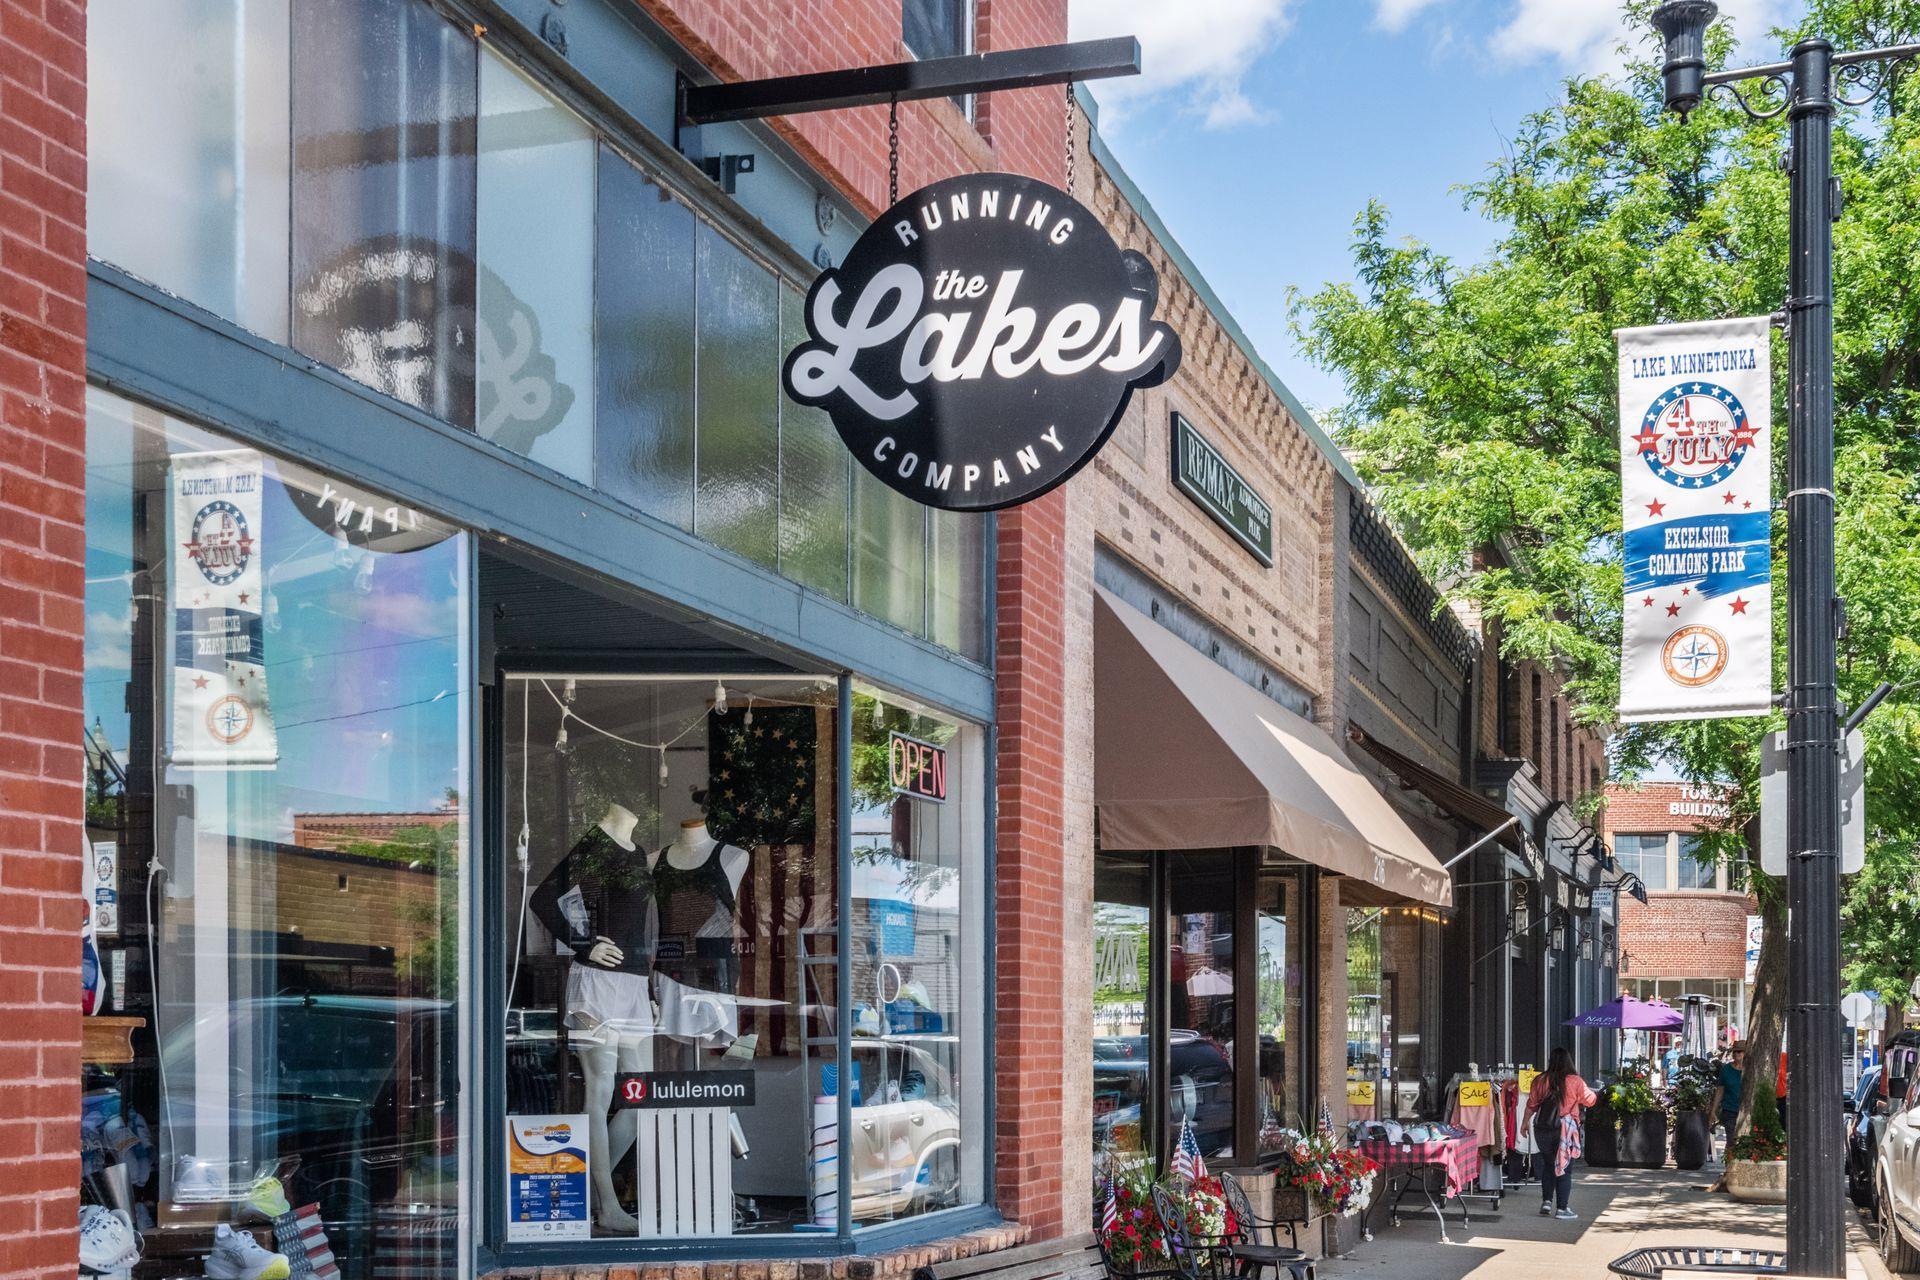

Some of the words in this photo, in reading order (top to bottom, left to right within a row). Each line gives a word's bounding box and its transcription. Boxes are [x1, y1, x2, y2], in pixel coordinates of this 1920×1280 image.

[895, 190, 1075, 246] RUNNING
[933, 269, 988, 300] the
[790, 263, 1164, 420] Lakes
[1632, 356, 1666, 379] LAKE
[1671, 348, 1757, 375] MINNETONKA
[873, 425, 1064, 491] COMPANY
[1658, 435, 1736, 466] JULY
[1664, 525, 1730, 550] EXCELSIOR
[1649, 553, 1709, 576] COMMONS
[1711, 551, 1747, 573] PARK
[892, 738, 946, 798] OPEN
[652, 1080, 745, 1099] lululemon
[1460, 1086, 1489, 1100] SALE
